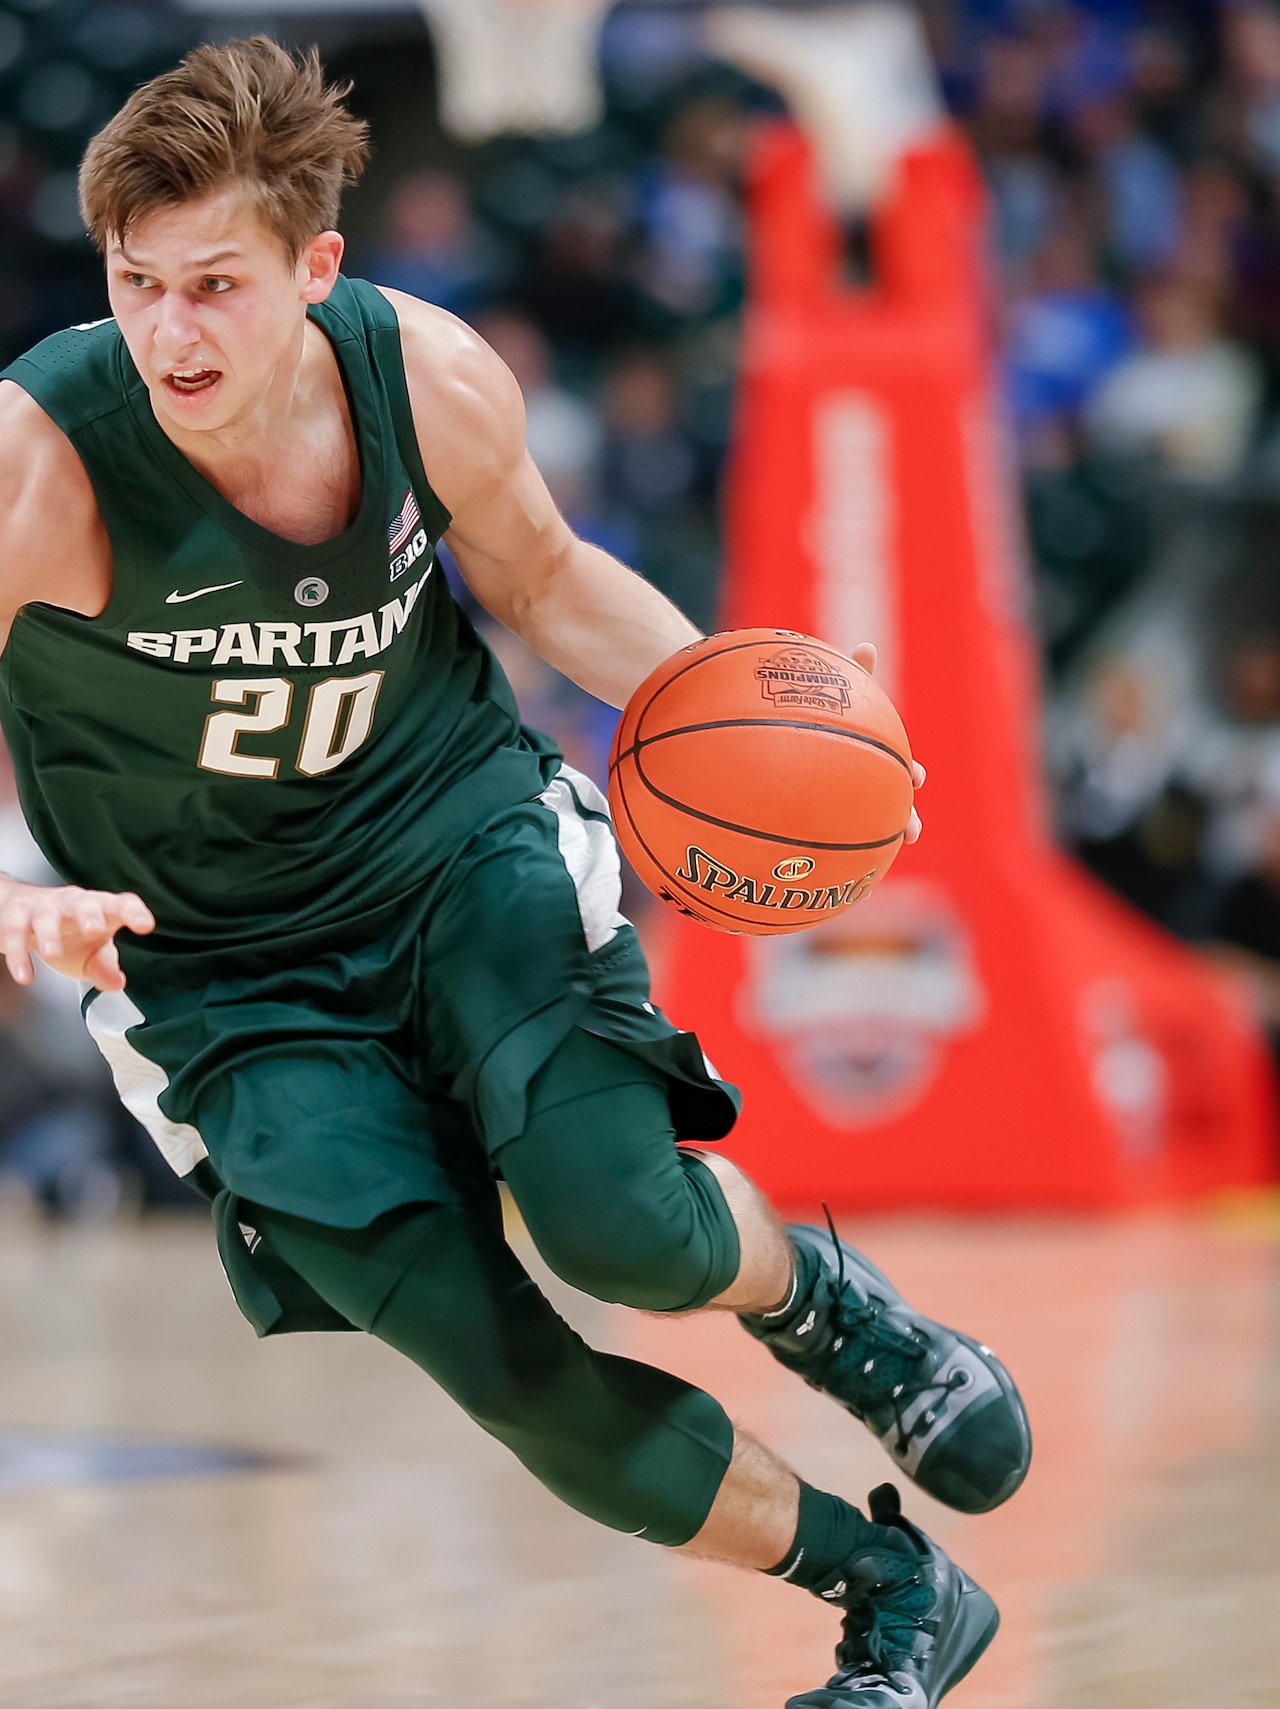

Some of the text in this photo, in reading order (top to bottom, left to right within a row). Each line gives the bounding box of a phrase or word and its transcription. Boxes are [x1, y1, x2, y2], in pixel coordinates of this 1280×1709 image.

[126, 562, 433, 667] SPARTAN
[756, 670, 848, 687] CHAMPIONS
[196, 670, 386, 780] 20
[676, 845, 877, 911] SPALDING
